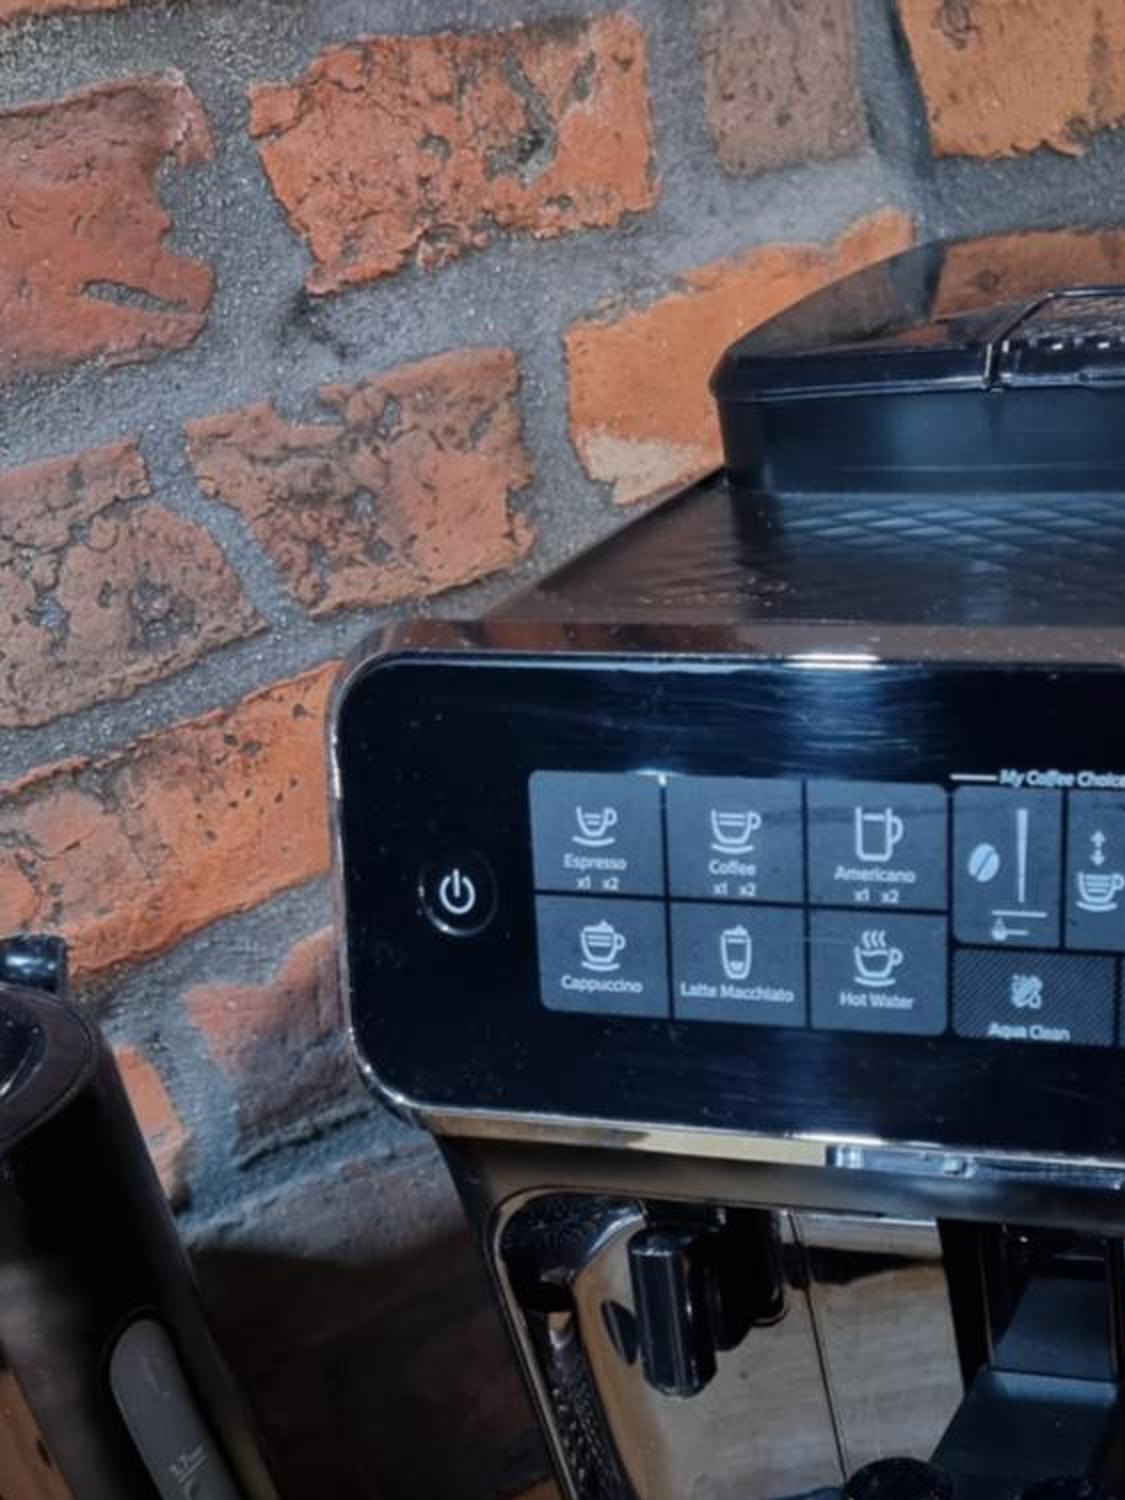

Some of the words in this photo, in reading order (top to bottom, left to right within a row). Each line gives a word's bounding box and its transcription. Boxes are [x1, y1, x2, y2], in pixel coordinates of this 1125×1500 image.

[1000, 770, 1023, 788] My
[1027, 770, 1074, 787] Coffee
[563, 853, 628, 873] Espresso
[708, 858, 757, 876] Coffee
[834, 865, 916, 883] Americano
[576, 877, 591, 889] x1
[602, 878, 619, 890] x2
[713, 882, 728, 895] x1
[739, 883, 756, 896] x2
[854, 889, 870, 902] x1
[881, 890, 899, 903] x2
[561, 975, 643, 995] Cappuccino
[680, 982, 718, 998] Latte
[720, 984, 795, 1004] Macchiato
[839, 991, 868, 1008] Hot
[870, 993, 915, 1010] Water
[988, 1022, 1028, 1042] Aqua
[1029, 1025, 1070, 1042] Clean
